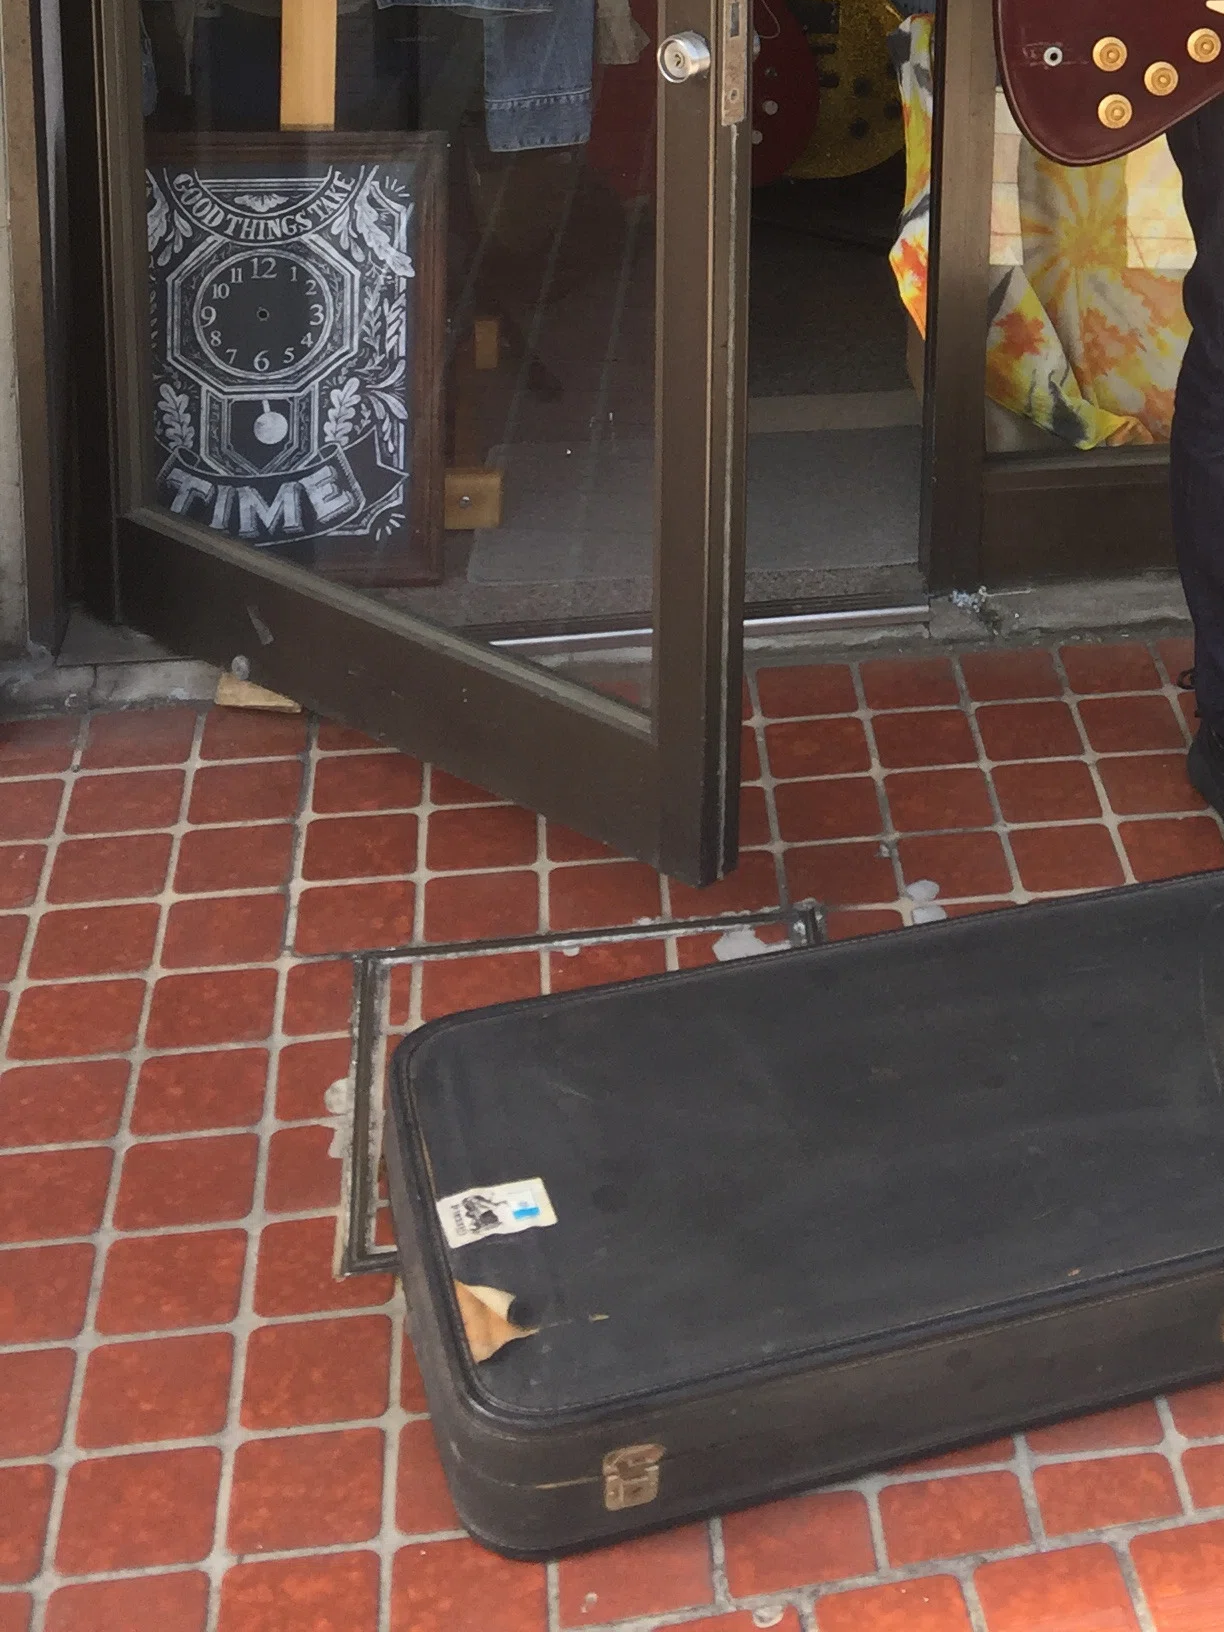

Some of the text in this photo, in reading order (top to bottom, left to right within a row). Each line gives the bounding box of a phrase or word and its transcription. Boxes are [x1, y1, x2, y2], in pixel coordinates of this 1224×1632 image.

[172, 170, 356, 241] GOOD THINGS TAKE
[230, 268, 244, 283] 11
[250, 256, 278, 280] 12
[290, 266, 298, 282] 1
[212, 283, 230, 299] 10
[306, 280, 317, 296] 2
[201, 306, 217, 327] 9
[309, 304, 326, 326] 3
[210, 330, 222, 347] 8
[301, 332, 314, 348] 4
[225, 348, 238, 365] 7
[253, 351, 270, 372] 6
[282, 347, 295, 364] 5
[166, 465, 356, 538] TIME
